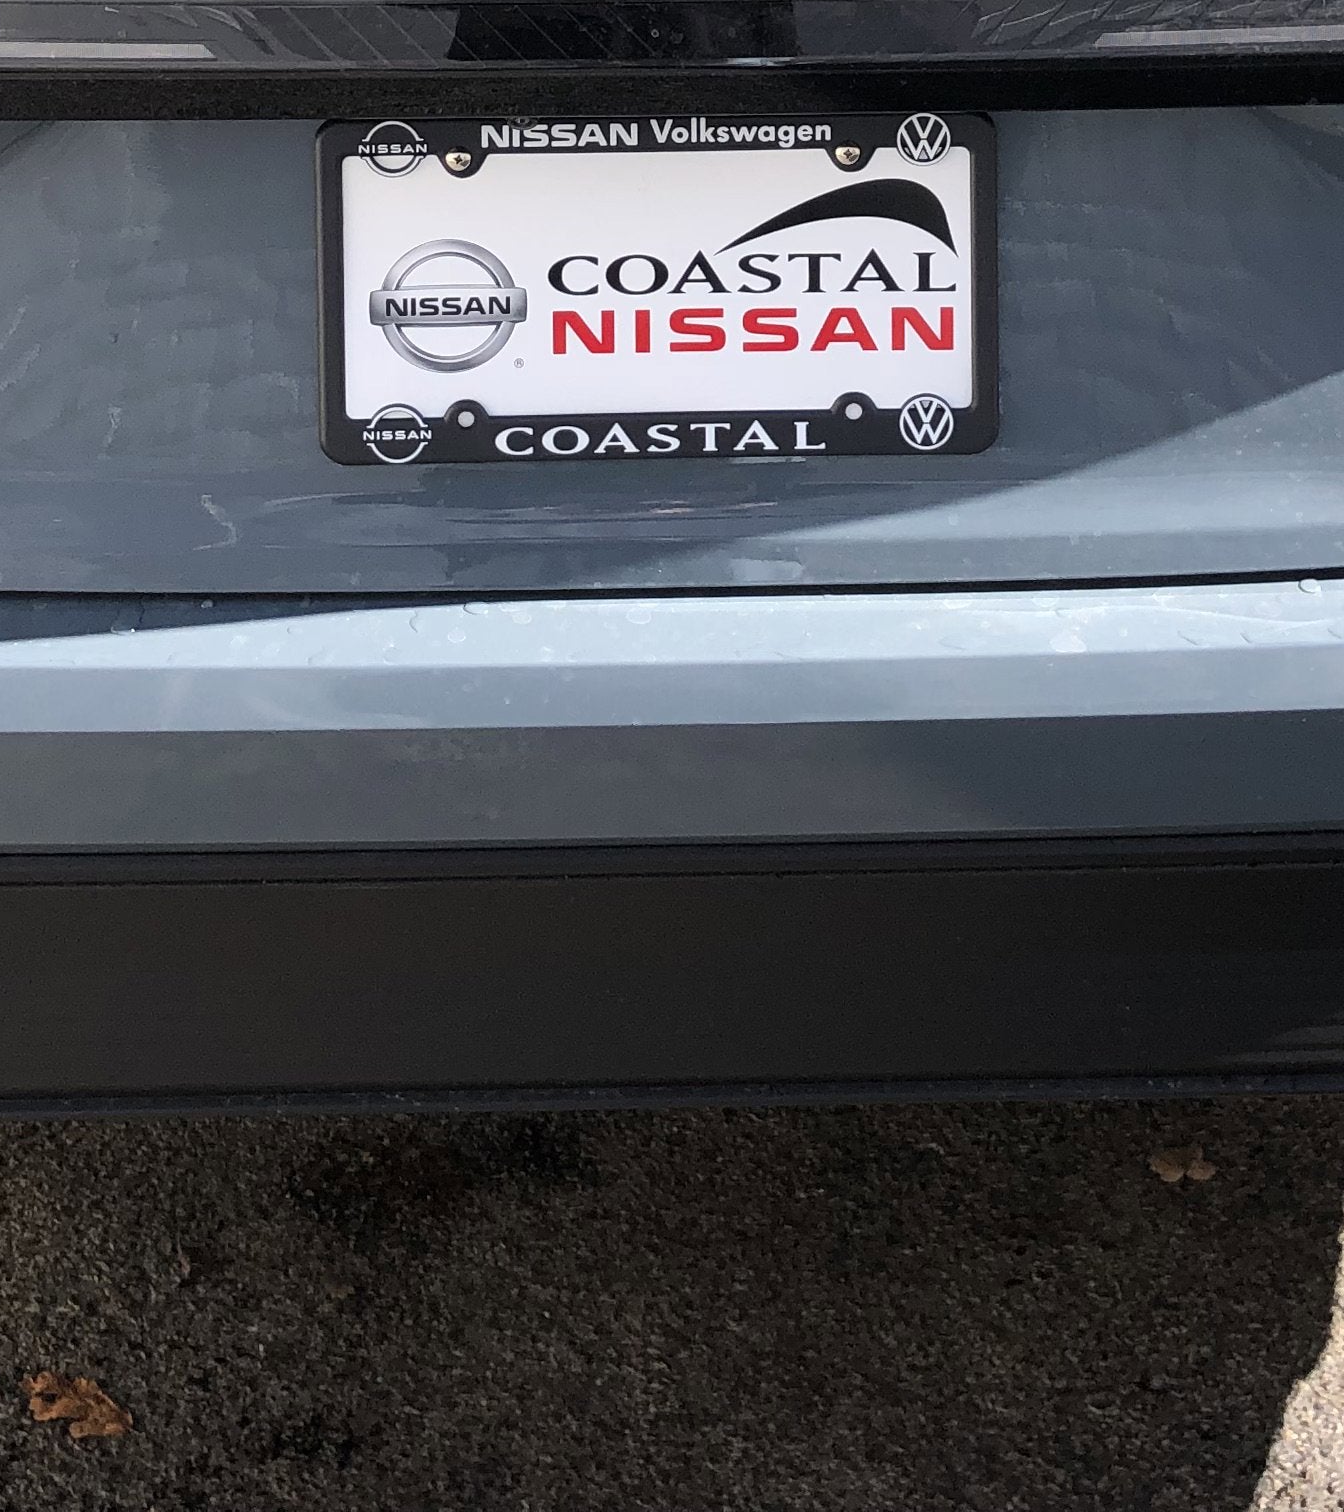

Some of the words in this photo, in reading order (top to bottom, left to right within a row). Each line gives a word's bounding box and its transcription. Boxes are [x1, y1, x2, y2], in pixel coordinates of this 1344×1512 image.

[357, 140, 429, 157] NISSAN
[480, 122, 639, 149] NISSAN
[650, 117, 833, 147] Volkswagen
[547, 247, 957, 296] COASTAL
[384, 294, 512, 317] NISSAN
[551, 306, 955, 355] NISSAN
[361, 425, 433, 444] NISSAN
[494, 420, 827, 457] COASTAL
